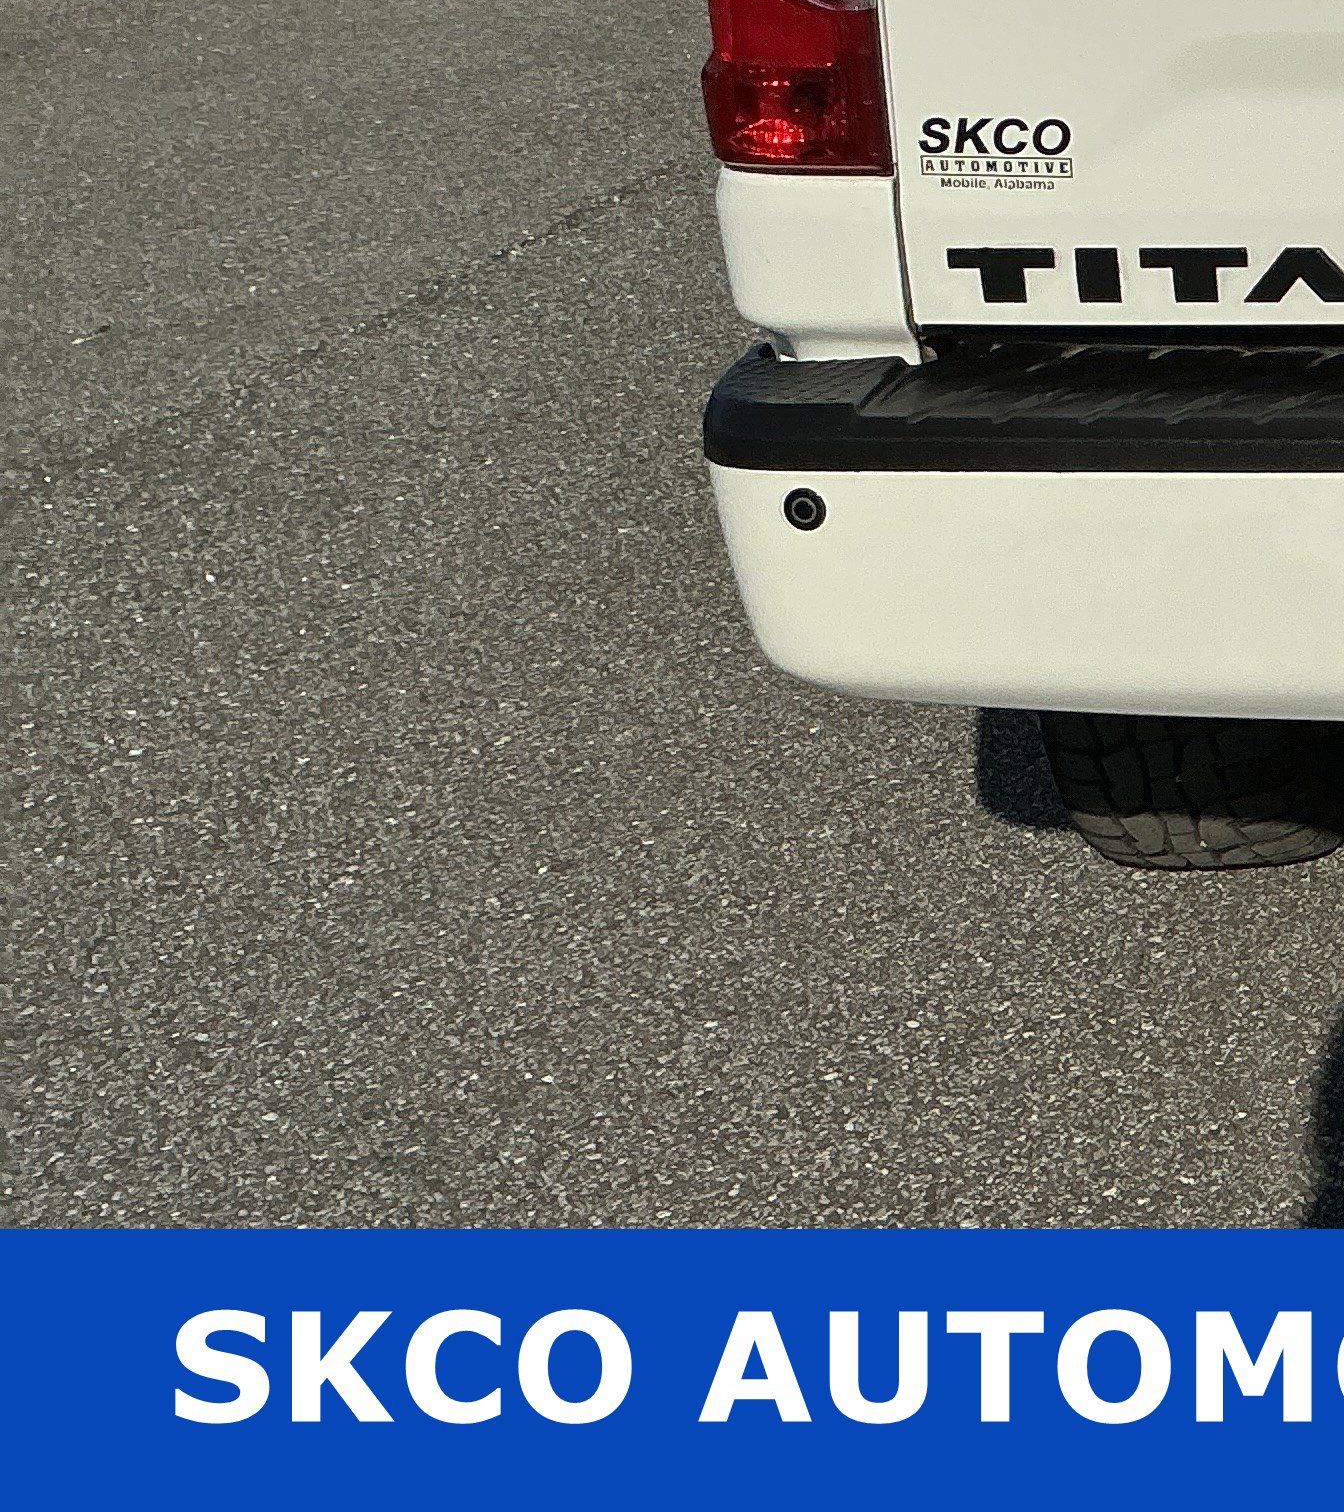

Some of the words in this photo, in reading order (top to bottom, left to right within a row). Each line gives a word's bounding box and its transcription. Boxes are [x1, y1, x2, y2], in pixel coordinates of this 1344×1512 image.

[918, 117, 1072, 156] SKCO
[923, 158, 1070, 175] AUTOMOTIVE
[940, 177, 990, 191] Mobile,
[994, 178, 1055, 191] Alabama
